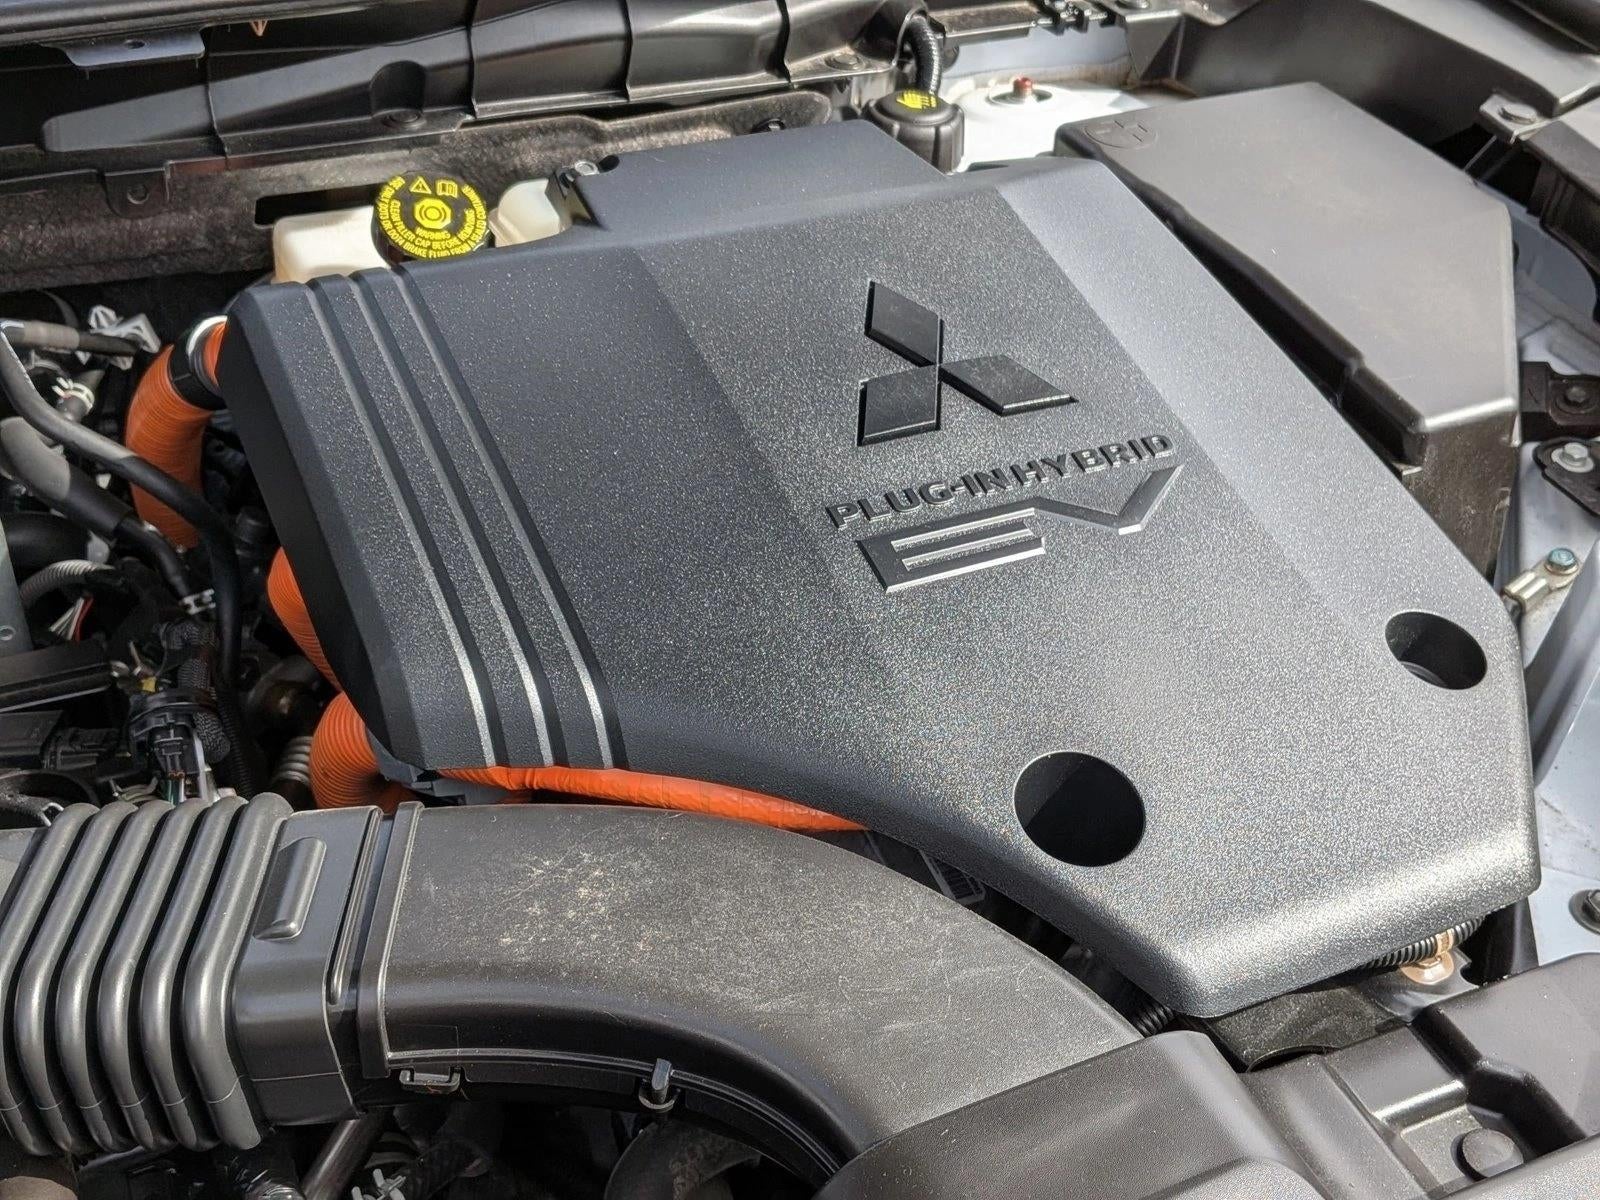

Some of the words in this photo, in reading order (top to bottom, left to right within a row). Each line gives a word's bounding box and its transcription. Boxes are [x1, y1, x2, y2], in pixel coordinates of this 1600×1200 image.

[378, 184, 395, 203] ONLY
[389, 199, 401, 221] CLEAN
[381, 220, 393, 231] OR
[393, 220, 416, 242] FILLER
[415, 226, 451, 241] WARNING
[388, 228, 405, 246] DOT4
[414, 237, 431, 248] CAP
[431, 236, 461, 250] BEFORE
[467, 239, 477, 249] A
[402, 241, 427, 258] BRAKE
[450, 242, 472, 256] FROM
[825, 467, 1013, 529] PLUG-IN
[1009, 434, 1174, 488] HYBRID
[855, 465, 1184, 595] EV
